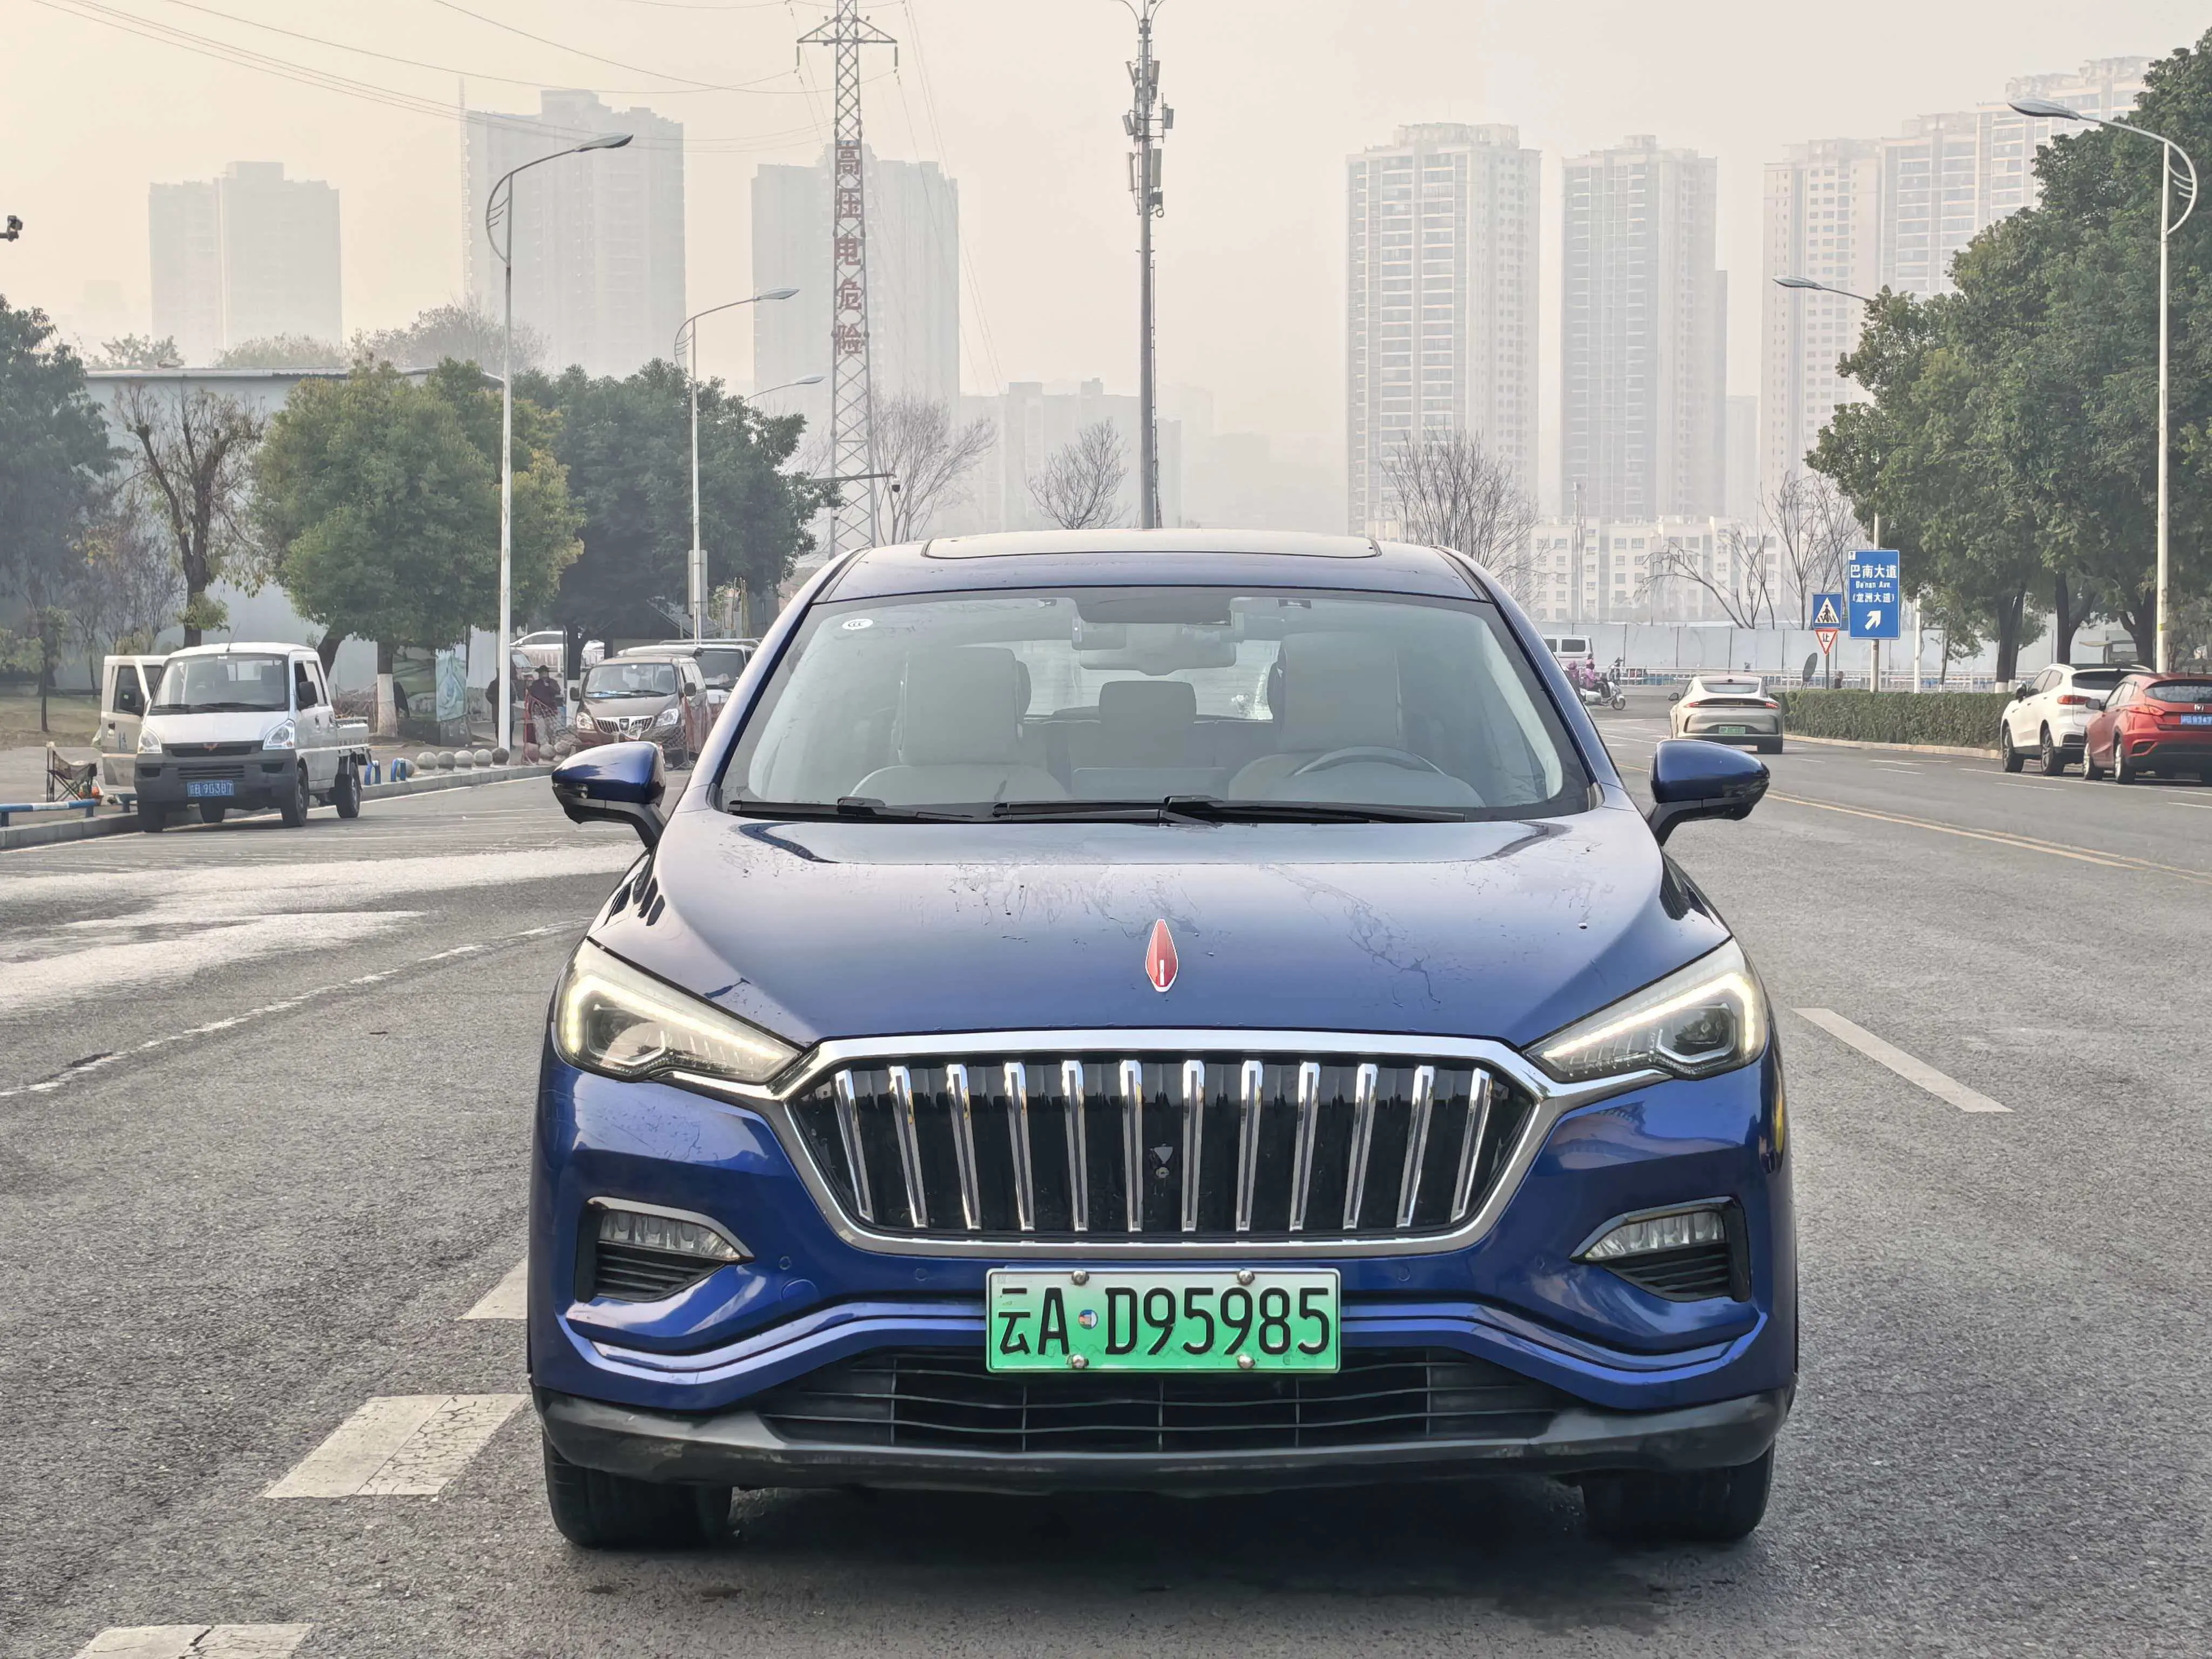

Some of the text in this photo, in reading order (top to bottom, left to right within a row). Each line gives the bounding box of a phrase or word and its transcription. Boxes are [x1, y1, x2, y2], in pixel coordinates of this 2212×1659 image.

[835, 141, 863, 355] 高压电危险
[1850, 563, 1897, 578] 巴南大道
